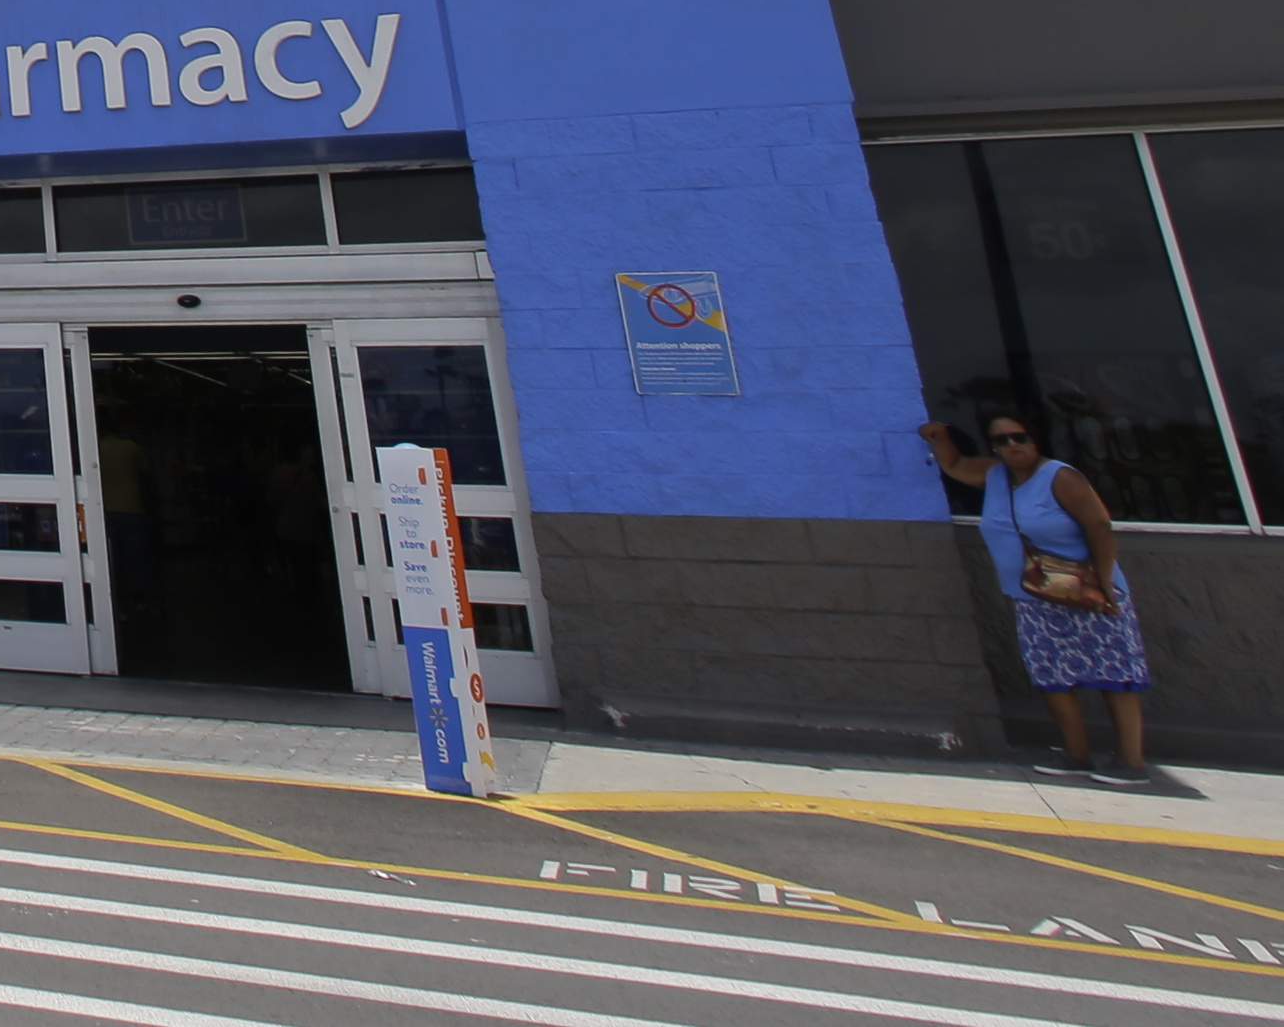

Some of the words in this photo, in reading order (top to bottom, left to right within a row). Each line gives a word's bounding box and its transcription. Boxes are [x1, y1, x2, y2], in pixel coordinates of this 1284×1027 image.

[142, 194, 229, 223] Enter
[636, 342, 678, 350] Attention
[389, 483, 420, 494] Order
[390, 495, 424, 506] online.
[398, 515, 420, 529] Ship
[406, 528, 417, 537] to
[403, 560, 427, 572] Save
[406, 575, 430, 584] even
[421, 641, 442, 705] Walmart
[539, 859, 841, 912] FIRE
